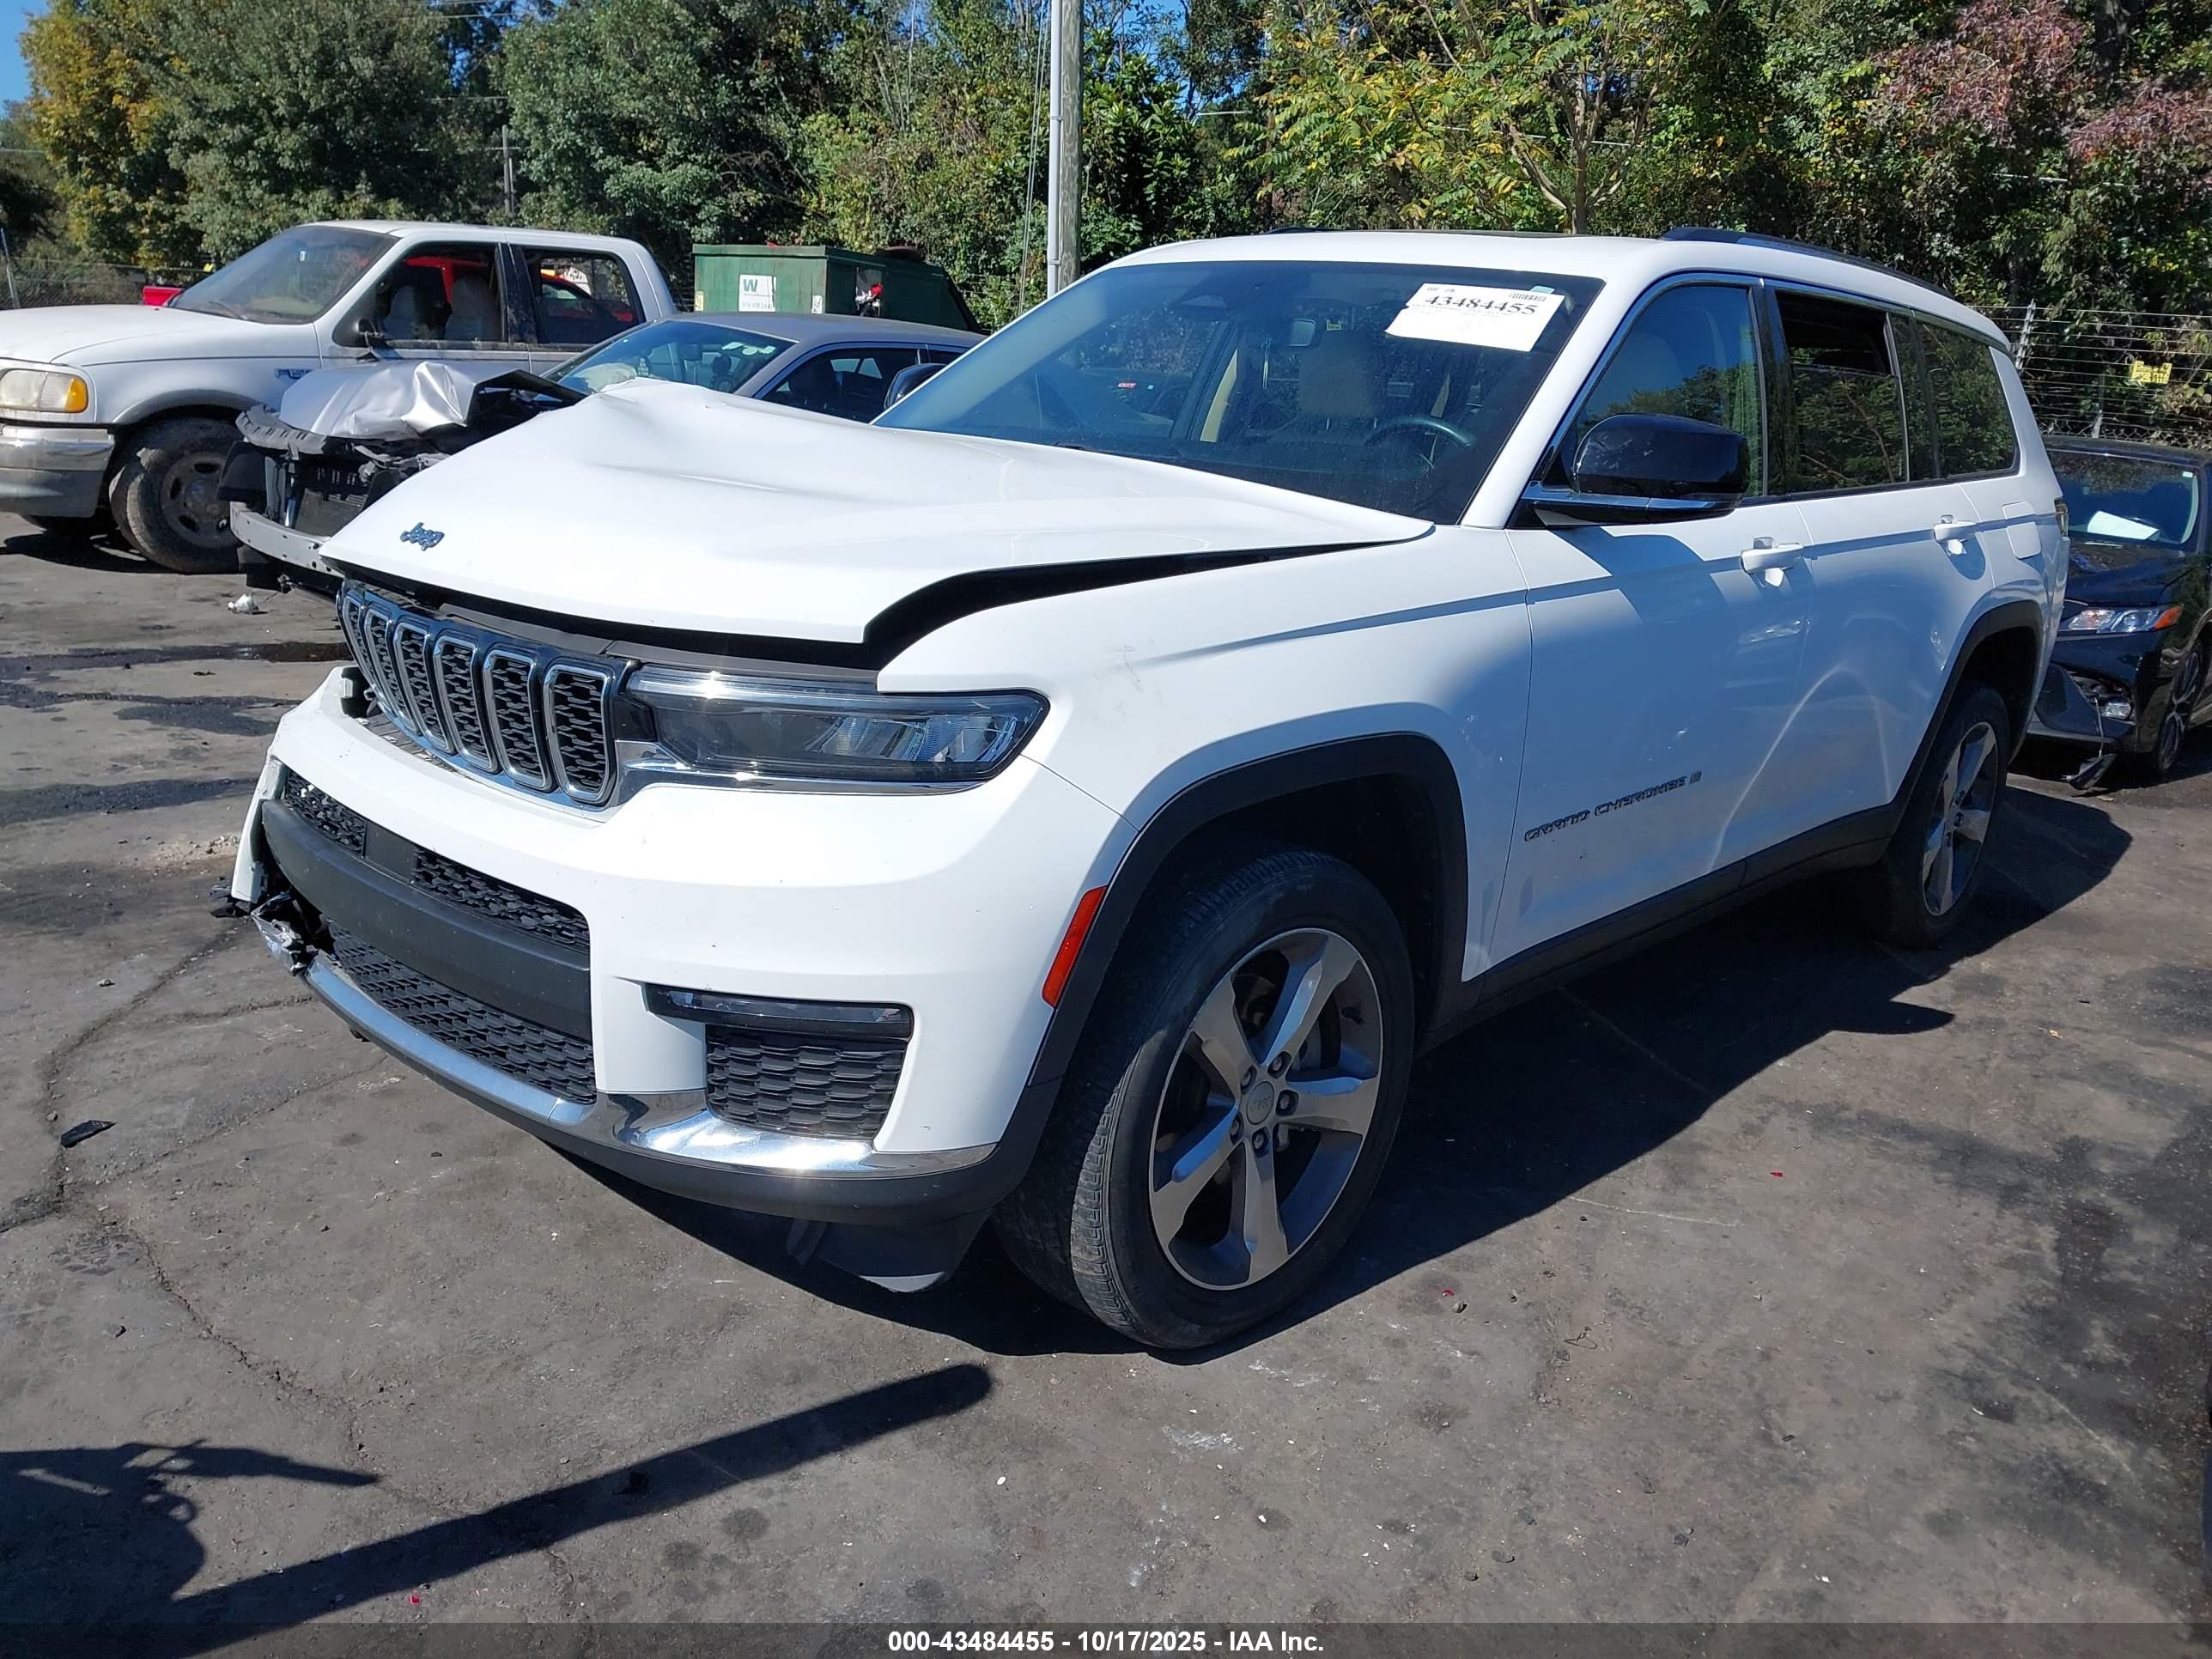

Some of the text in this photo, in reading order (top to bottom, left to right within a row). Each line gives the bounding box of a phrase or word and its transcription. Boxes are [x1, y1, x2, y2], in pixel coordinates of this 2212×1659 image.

[1425, 295, 1538, 315] 43484455
[400, 521, 445, 551] Jeep
[1524, 775, 1687, 842] GRAND CHEROKEE
